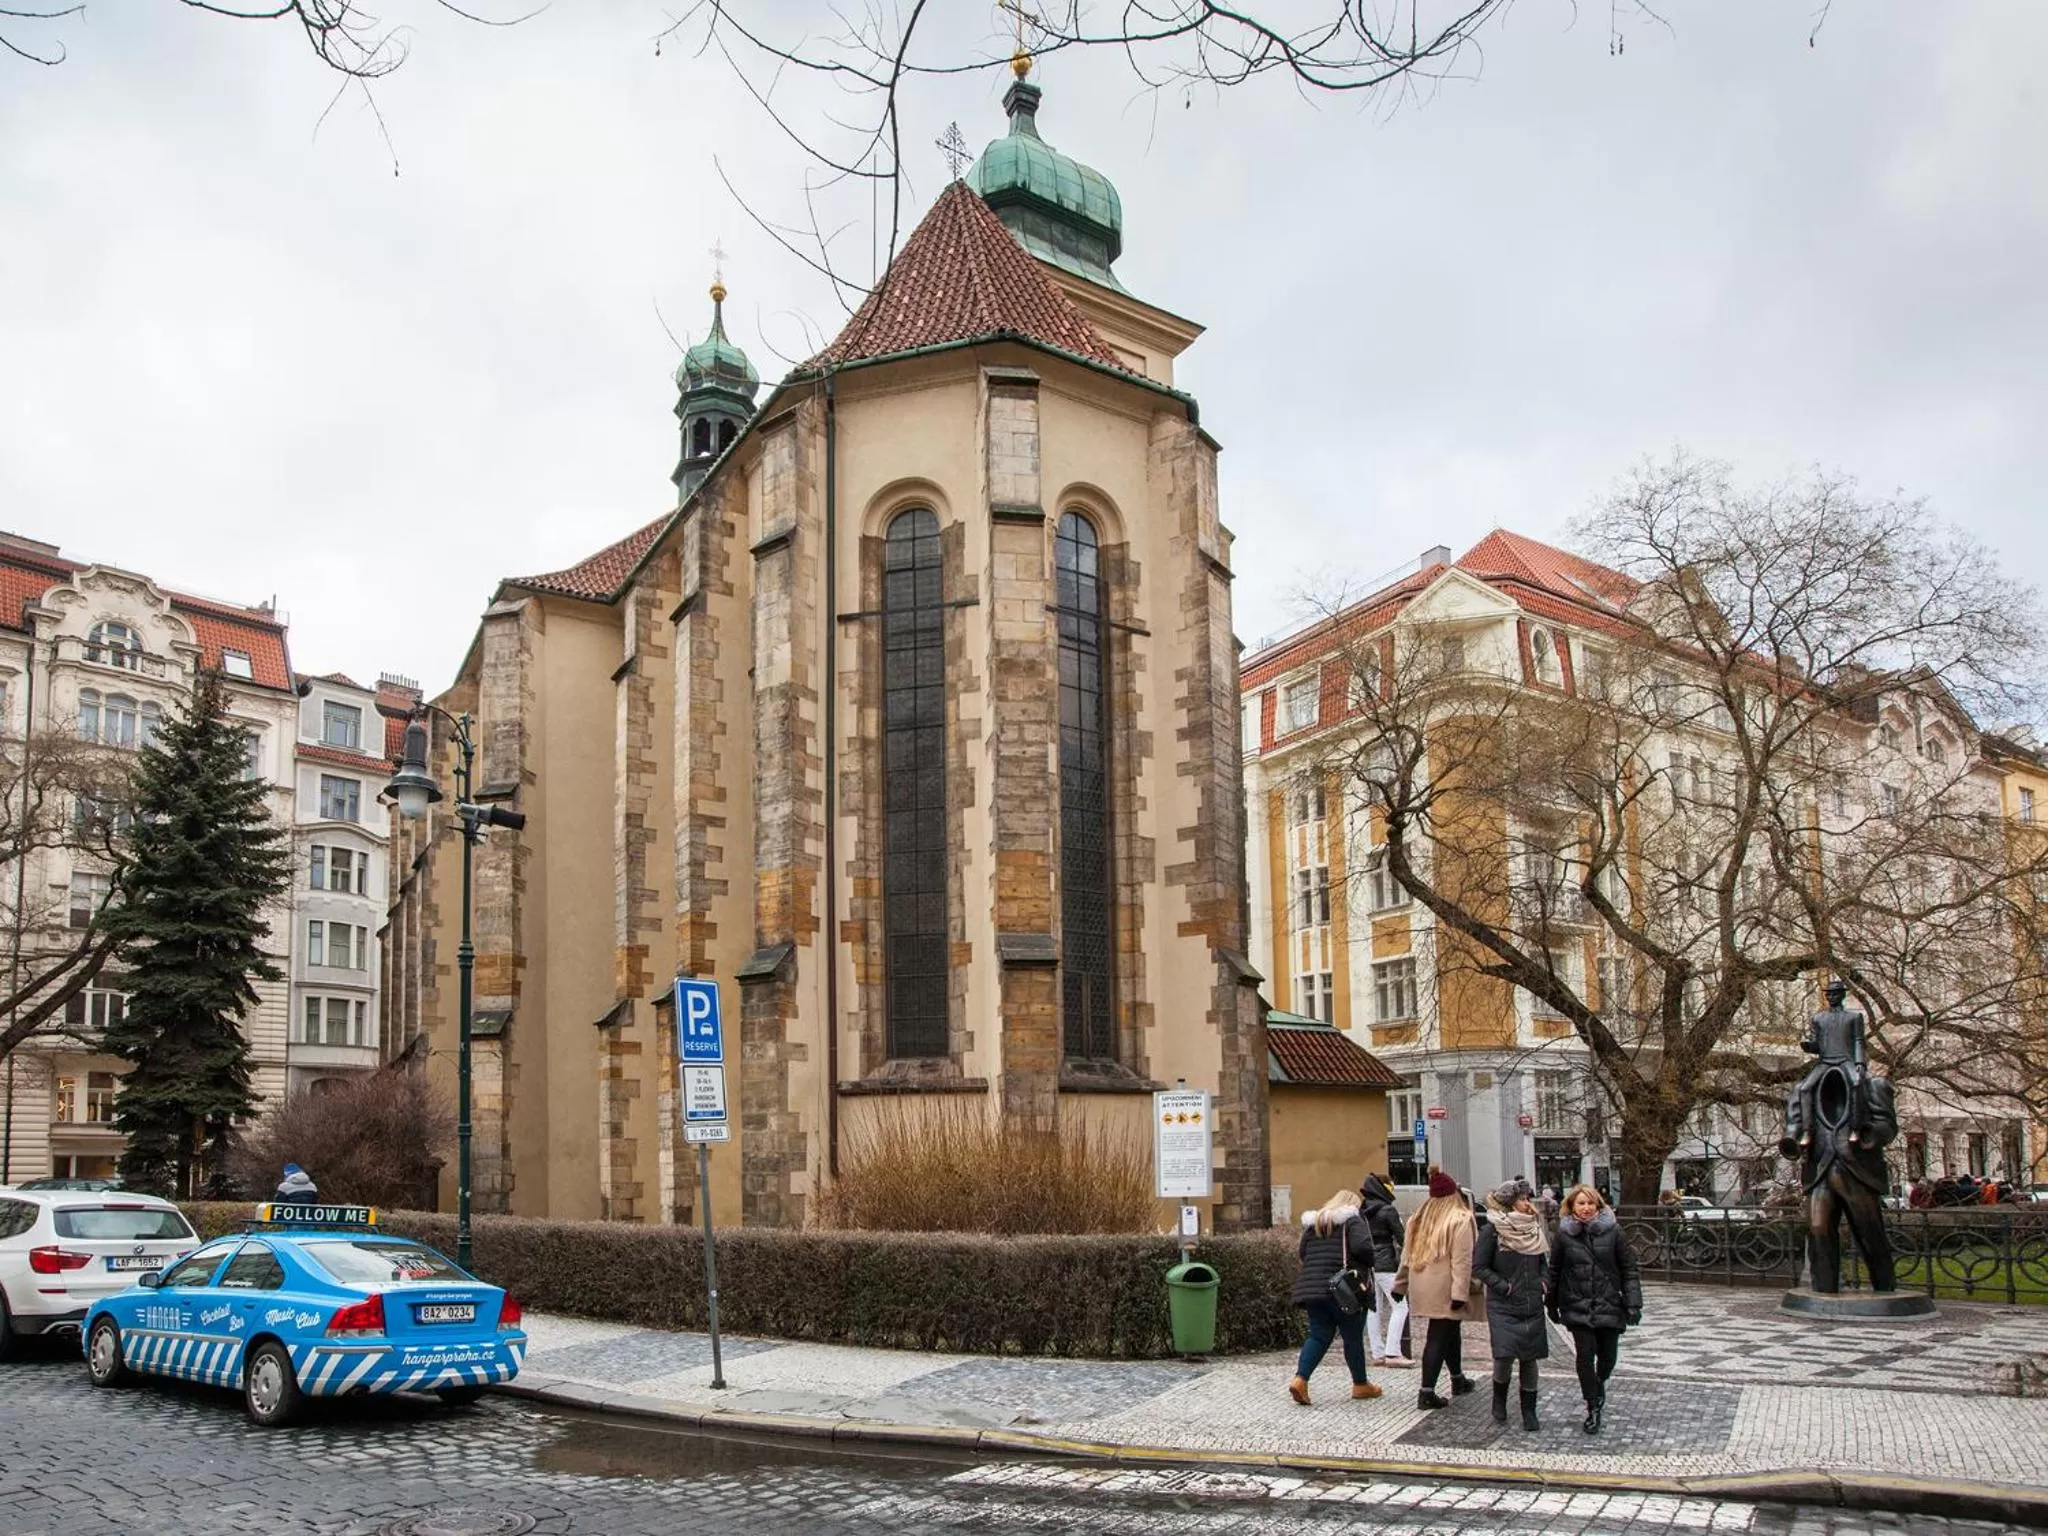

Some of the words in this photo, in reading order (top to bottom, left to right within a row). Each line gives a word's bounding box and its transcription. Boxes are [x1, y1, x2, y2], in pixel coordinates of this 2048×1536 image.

[687, 990, 711, 1036] P
[1417, 1122, 1423, 1132] P
[273, 1207, 339, 1221] FOLLOW
[344, 1209, 367, 1222] ME
[146, 1306, 181, 1330] HANGAR
[200, 1303, 231, 1326] Cocktail
[229, 1315, 244, 1332] Bar
[265, 1307, 295, 1326] Music
[295, 1311, 321, 1330] Club
[402, 1351, 495, 1367] hangarpraha.cz
